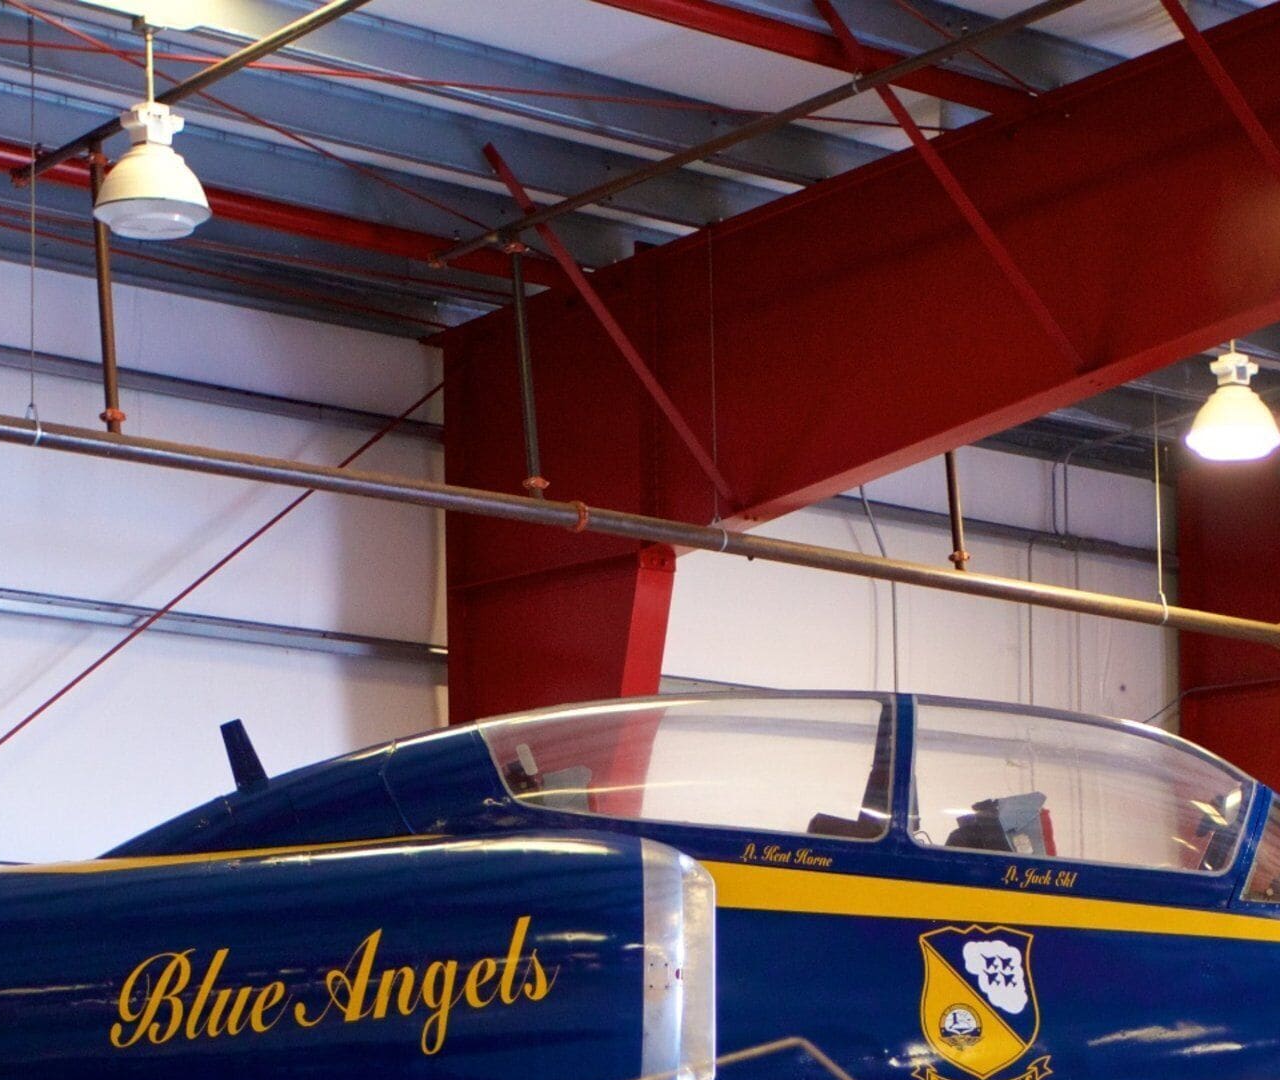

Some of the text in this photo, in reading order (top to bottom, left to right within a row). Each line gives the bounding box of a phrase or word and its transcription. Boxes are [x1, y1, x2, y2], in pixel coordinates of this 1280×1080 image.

[739, 842, 757, 862] Lt.
[761, 845, 791, 863] Kent
[1001, 866, 1018, 885] Lt.
[1020, 868, 1053, 888] Jack
[110, 916, 560, 1055] Blue Angels
